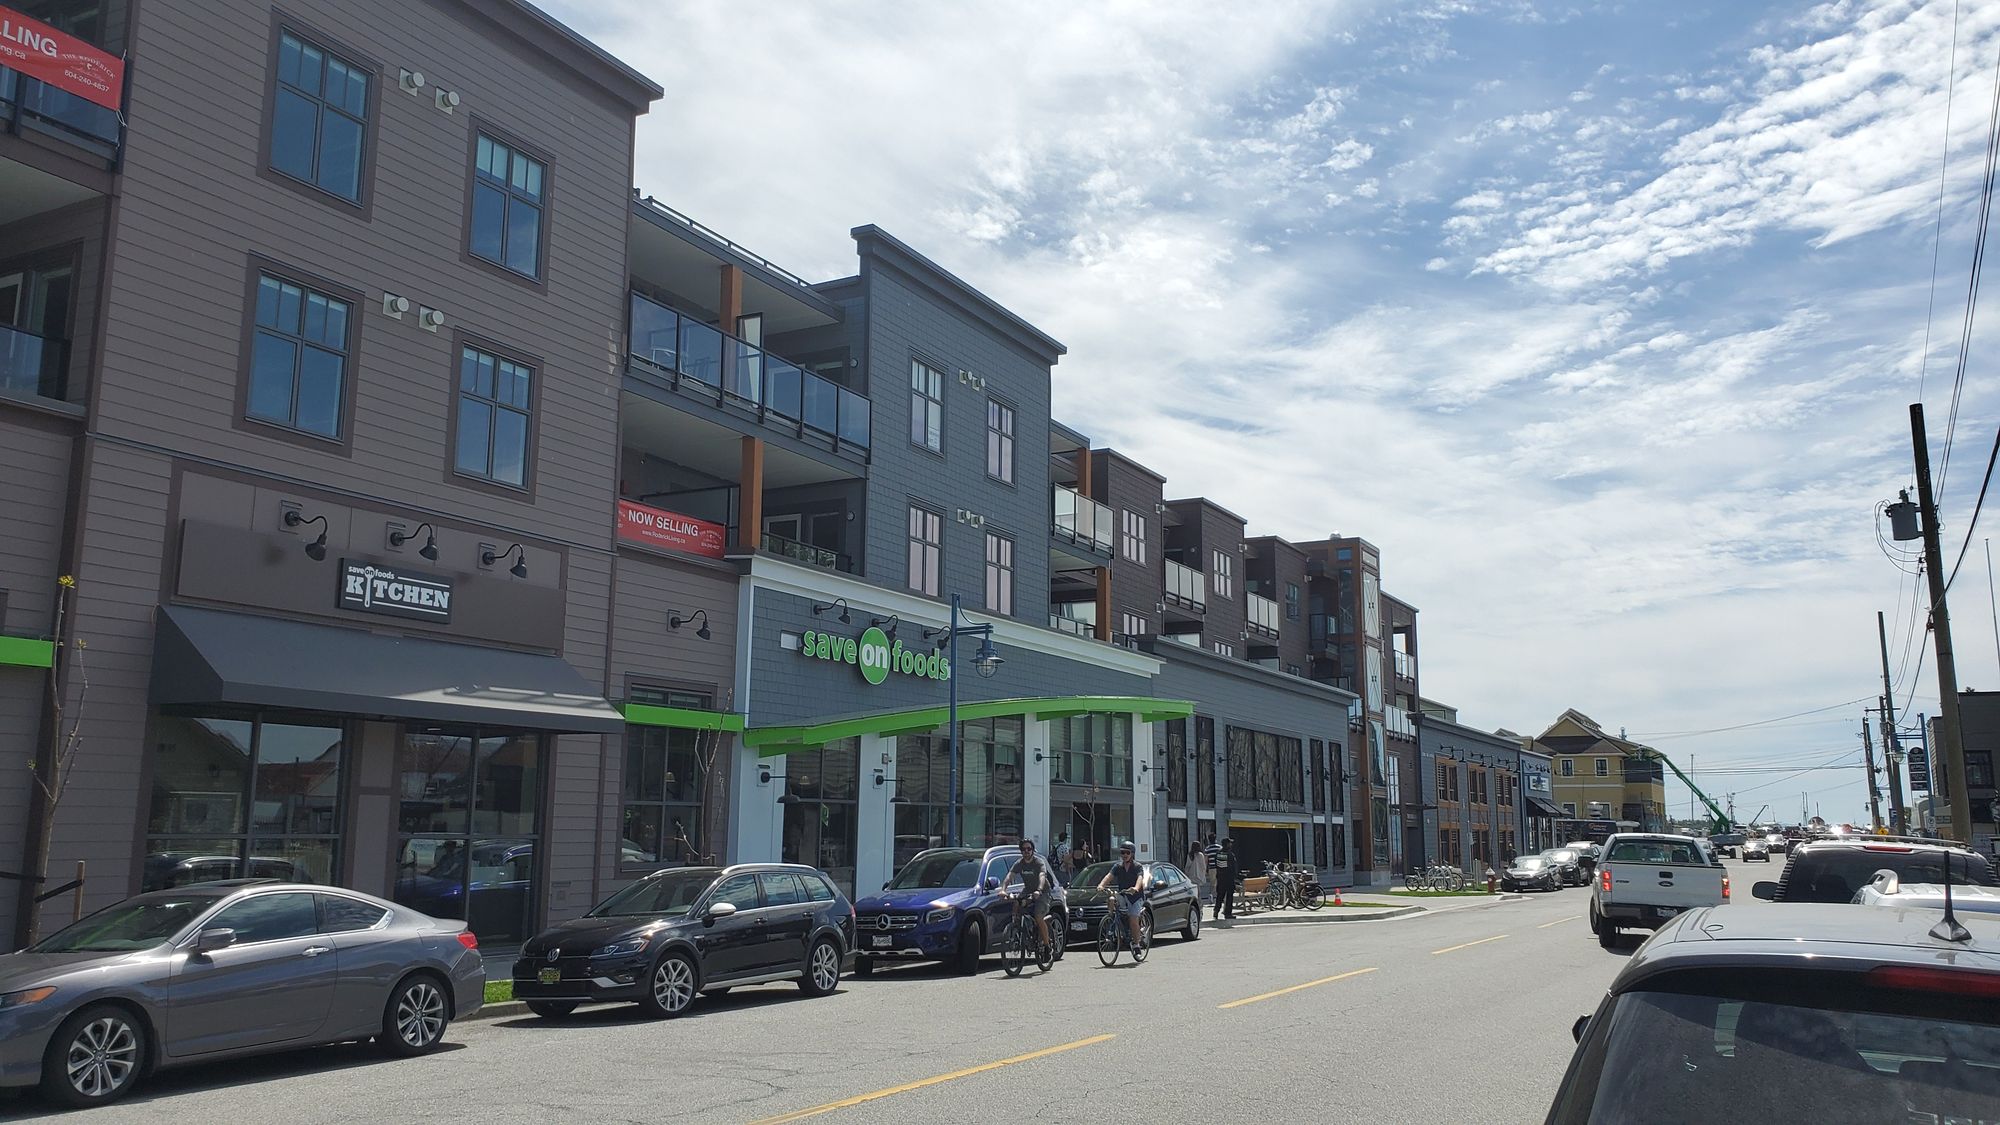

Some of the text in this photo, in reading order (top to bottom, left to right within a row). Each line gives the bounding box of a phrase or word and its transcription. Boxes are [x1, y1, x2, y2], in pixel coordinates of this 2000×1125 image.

[0, 20, 57, 58] LING
[628, 509, 655, 526] NOW
[656, 516, 699, 537] SELLING
[348, 565, 364, 574] save
[374, 568, 395, 580] foods
[346, 574, 449, 608] KITCHEN
[803, 630, 949, 681] save on foods
[1259, 798, 1289, 813] PARKING
